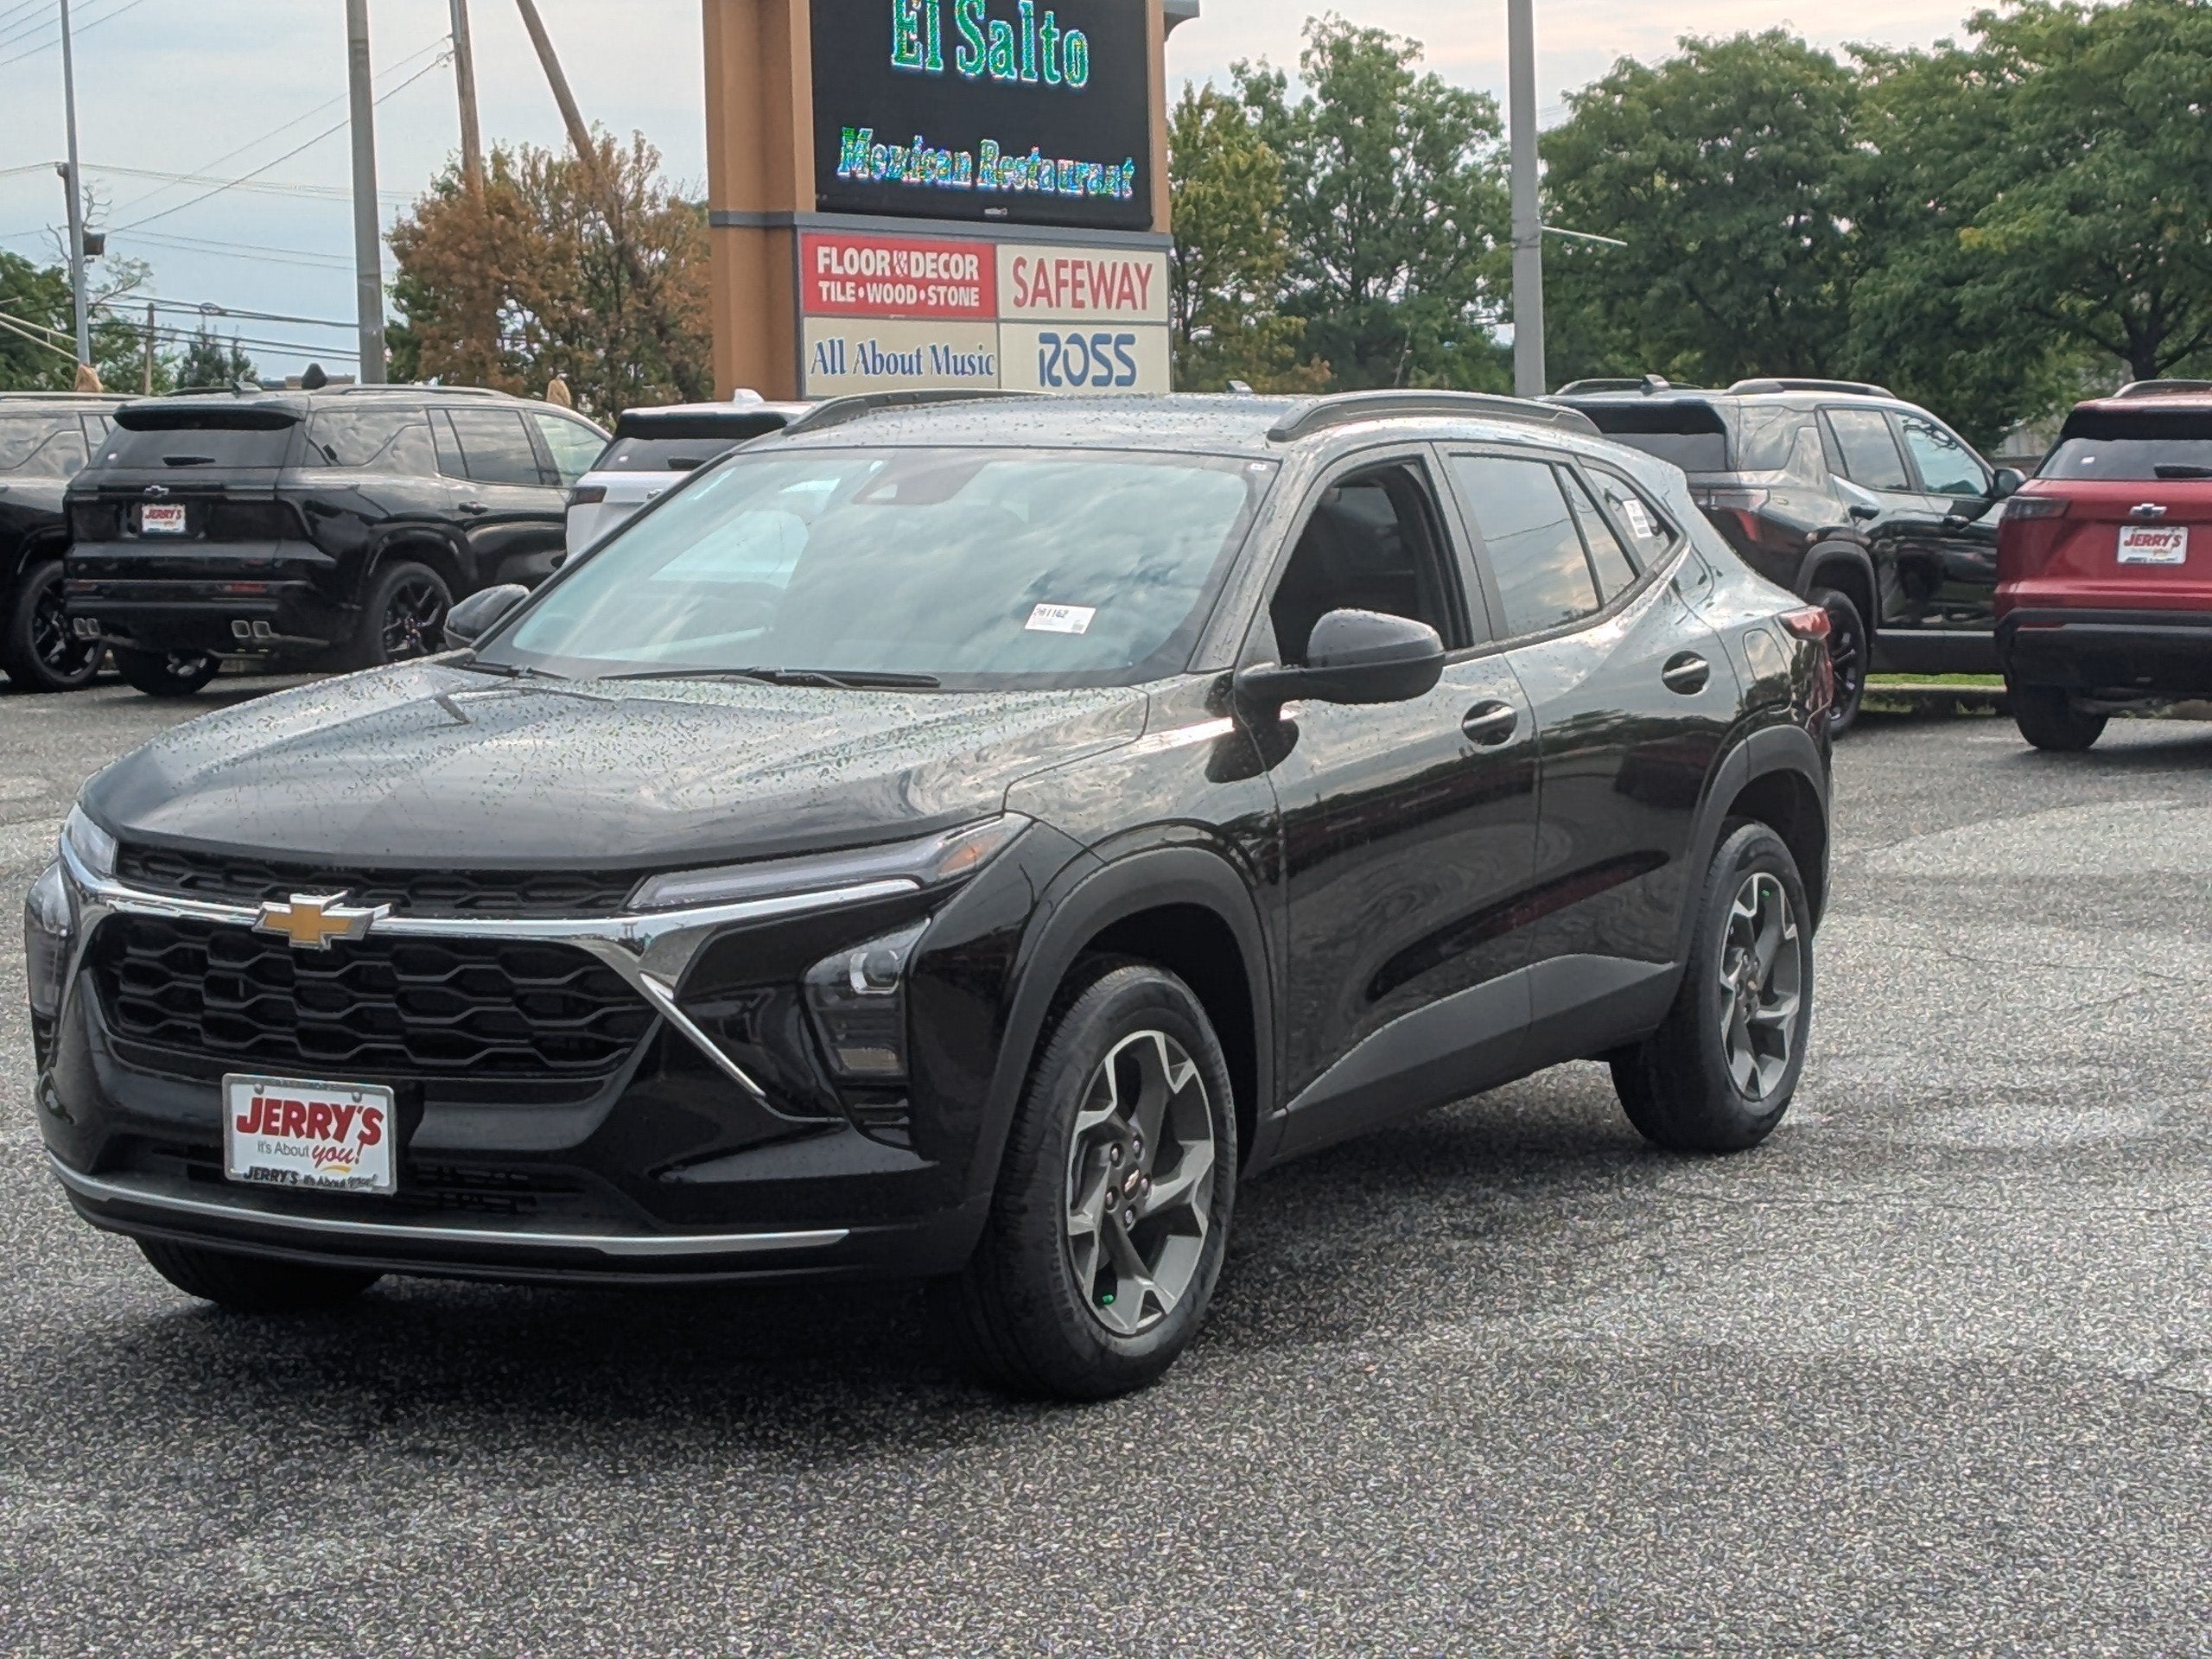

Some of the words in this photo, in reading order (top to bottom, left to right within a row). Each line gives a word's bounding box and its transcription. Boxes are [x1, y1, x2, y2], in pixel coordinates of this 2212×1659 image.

[891, 0, 944, 72] El
[955, 0, 1090, 87] Salto
[836, 126, 973, 188] Mexican
[977, 138, 1135, 200] Restaurant
[817, 245, 892, 277] FLOOR
[910, 251, 980, 281] DECOR
[1012, 256, 1153, 311] SAFEWAY
[810, 338, 846, 377] All
[852, 340, 924, 376] About
[929, 343, 995, 378] Music
[1039, 332, 1136, 387] ROSS
[145, 509, 181, 520] JERRY'S
[2124, 533, 2183, 548] JERRY'S
[236, 1096, 384, 1146] JERRY'S
[257, 1140, 272, 1154] It's
[274, 1141, 310, 1158] About
[311, 1141, 364, 1168] you!
[243, 1165, 299, 1185] JERRY'S
